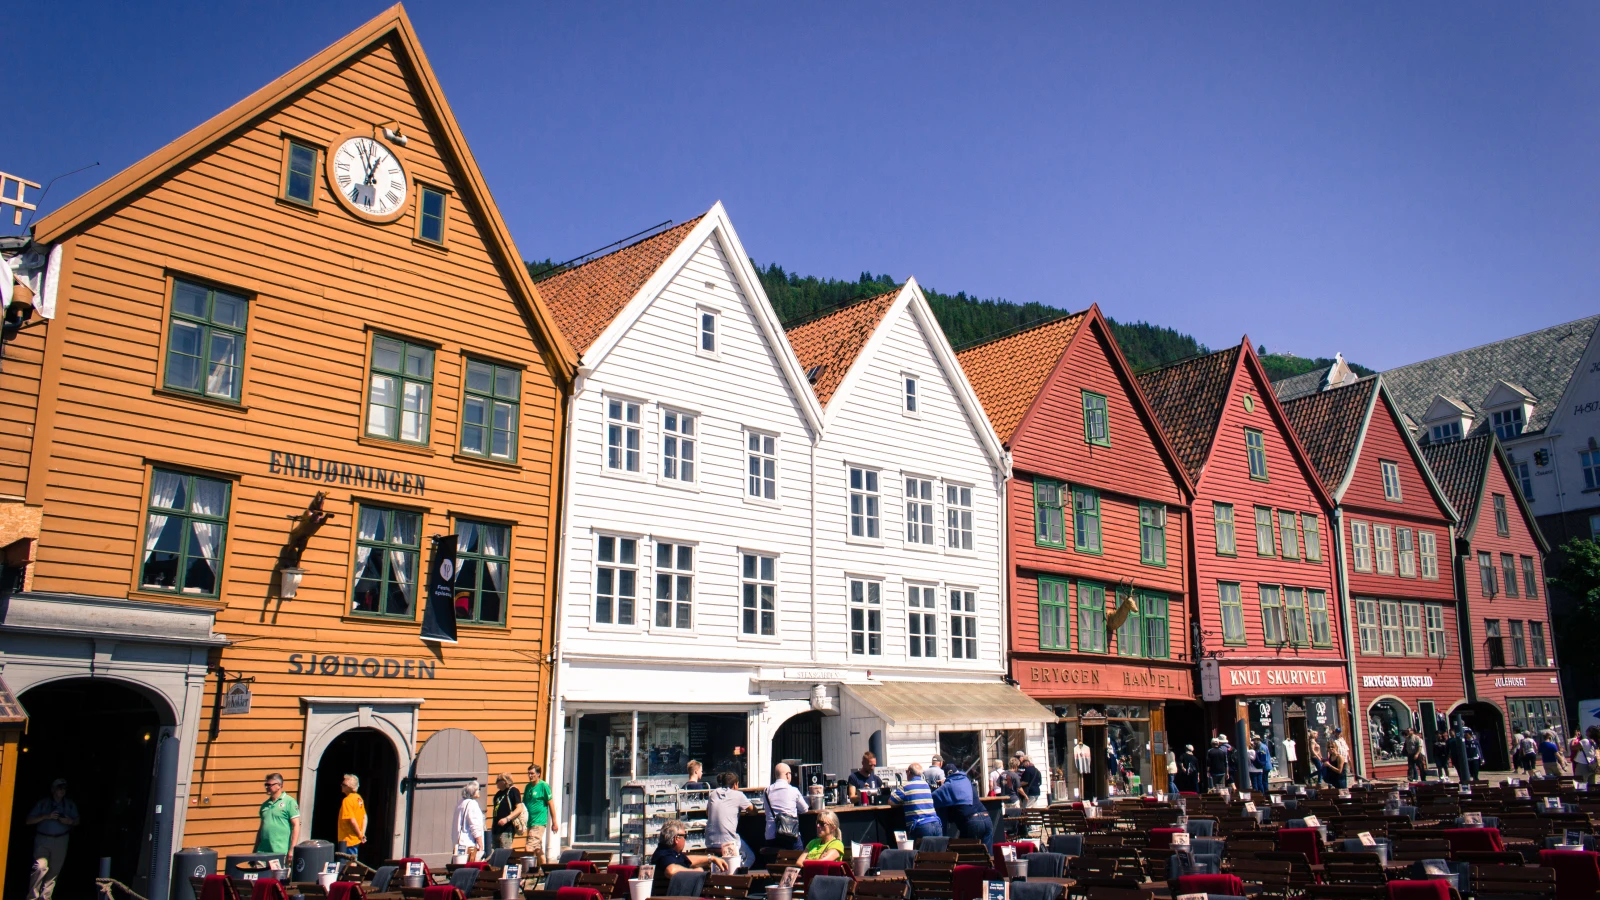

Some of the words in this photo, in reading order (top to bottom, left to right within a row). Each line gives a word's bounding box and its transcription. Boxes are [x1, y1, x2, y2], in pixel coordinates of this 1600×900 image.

[269, 451, 426, 496] ENHJØRNINGEN
[288, 653, 435, 680] SJØBODEN
[1031, 667, 1100, 684] BRYGGEN
[1123, 671, 1175, 688] HANDEL
[1230, 669, 1261, 686] KNUT
[1267, 669, 1327, 686] SKURTVEIT
[1363, 675, 1399, 688] BRYGGEN
[1401, 675, 1433, 688] HUSFLID
[1494, 677, 1527, 688] JULEHUSET
